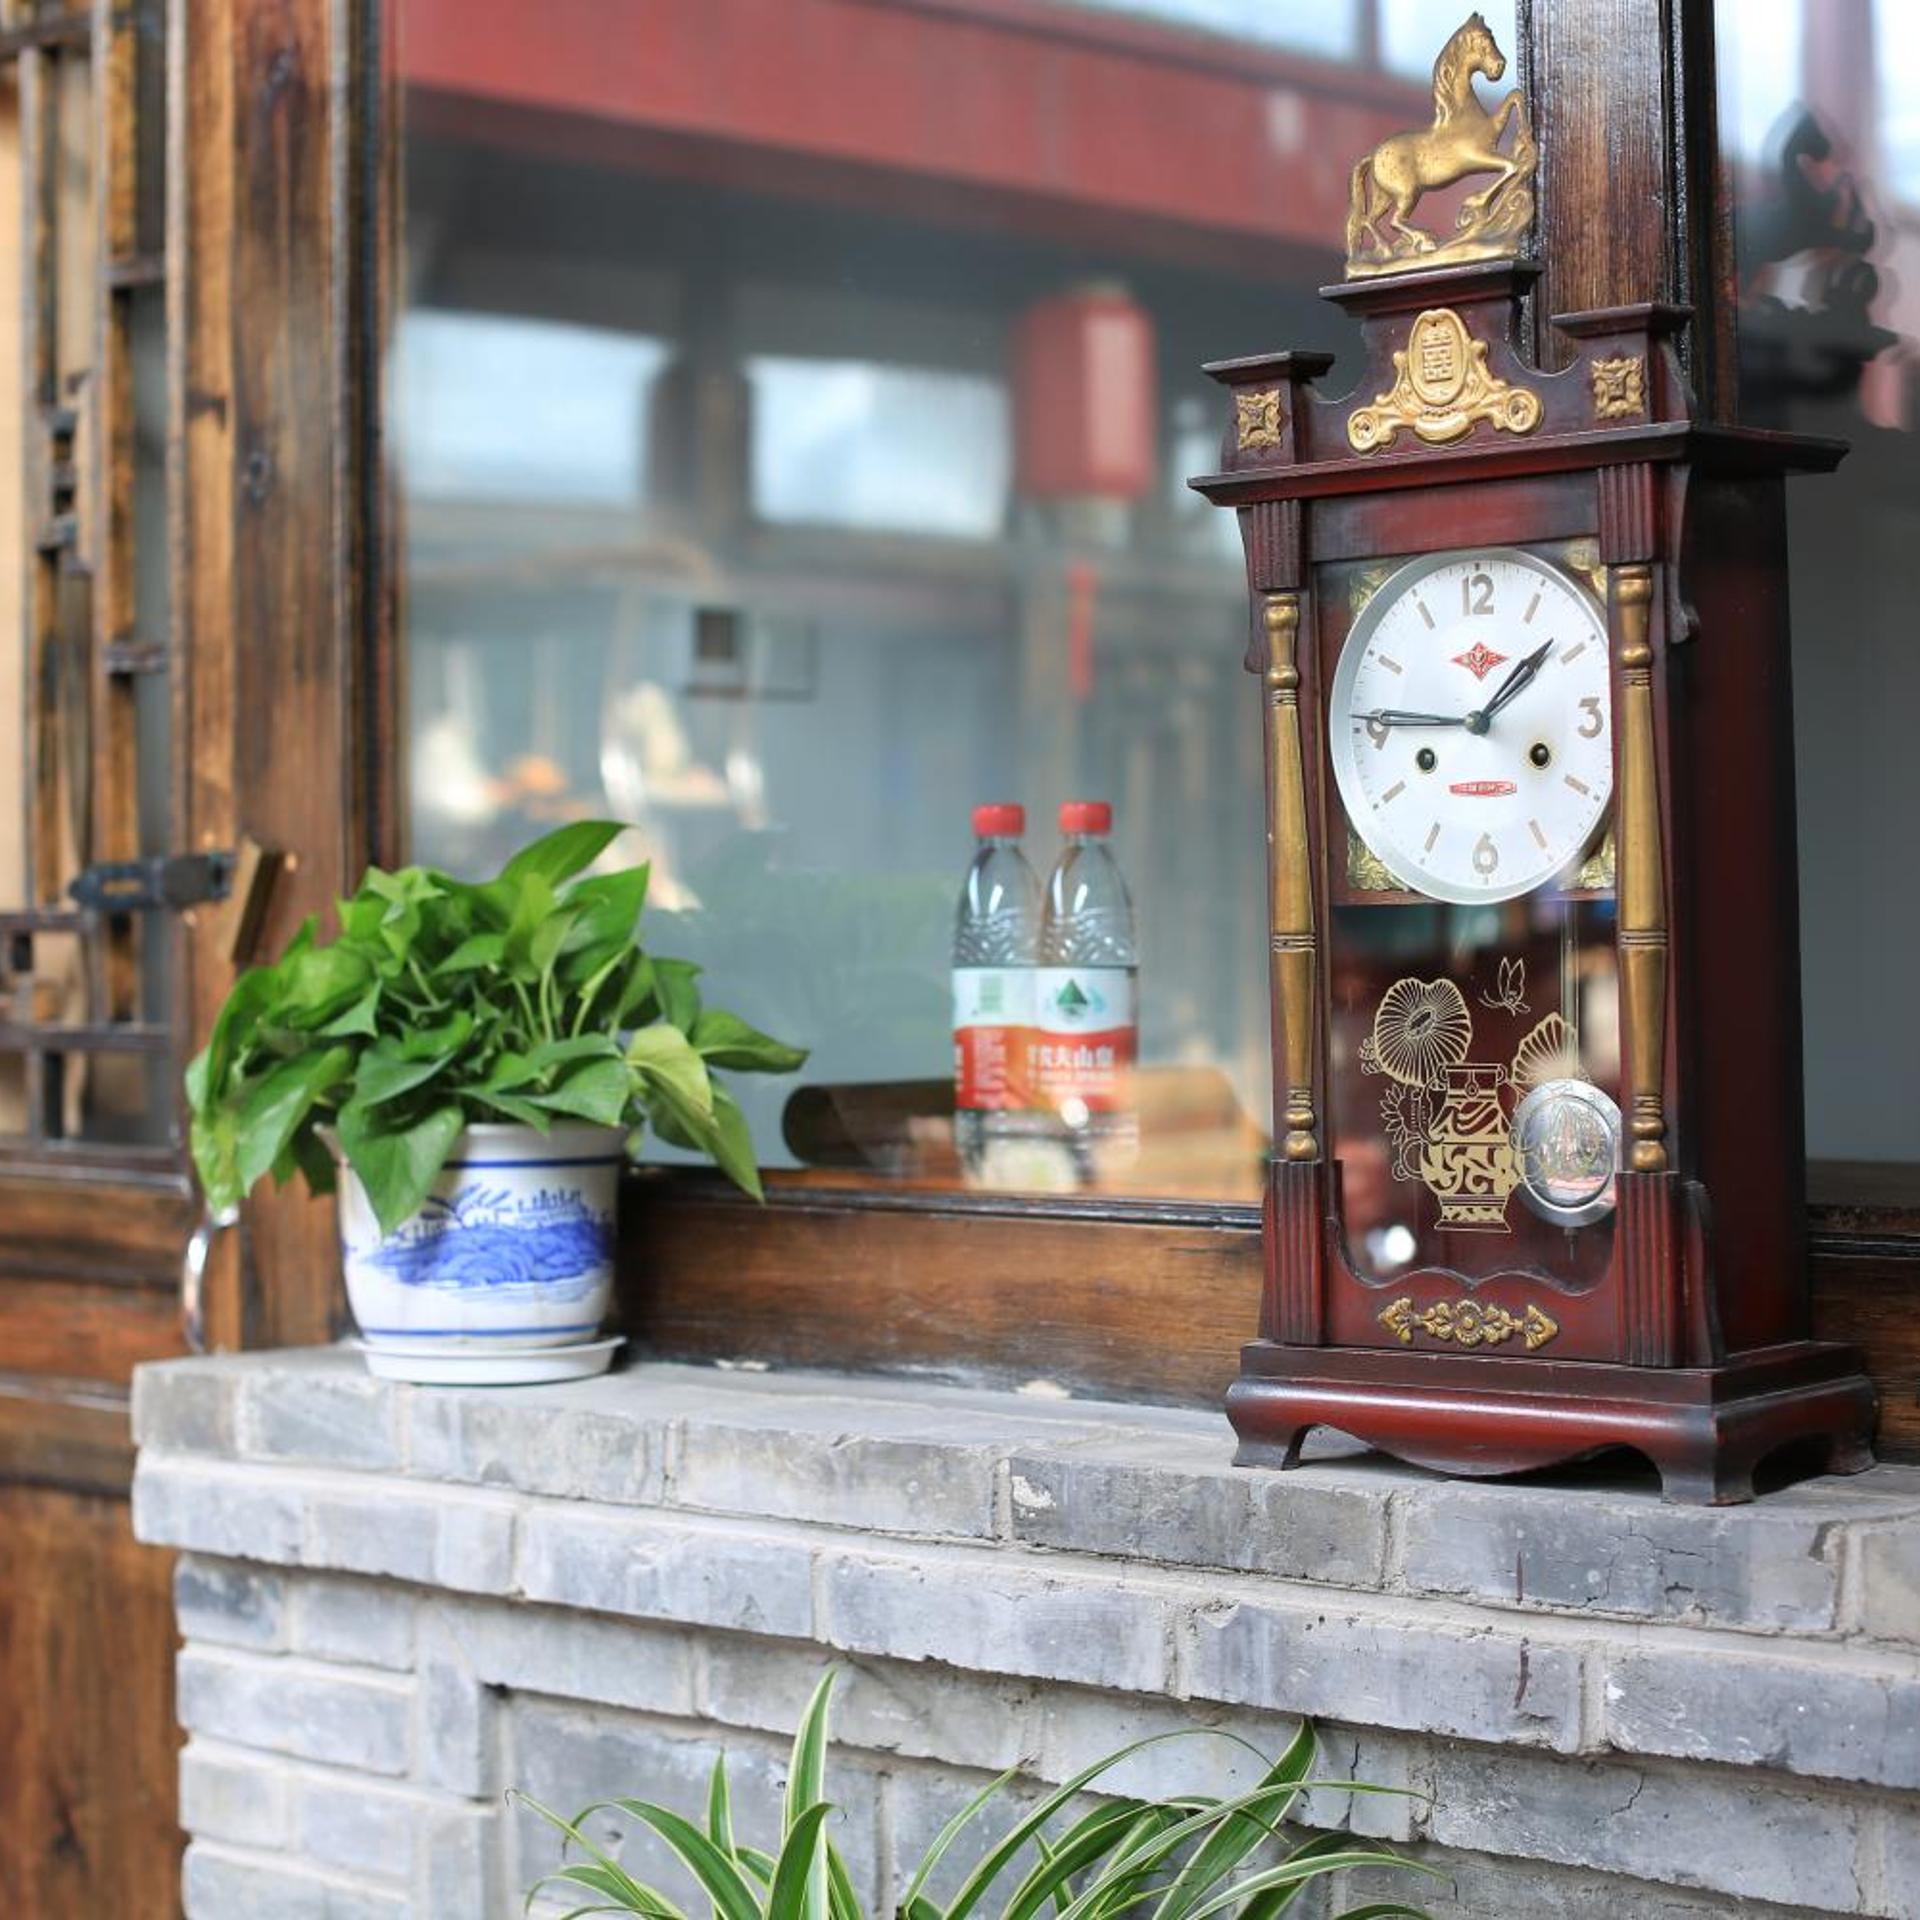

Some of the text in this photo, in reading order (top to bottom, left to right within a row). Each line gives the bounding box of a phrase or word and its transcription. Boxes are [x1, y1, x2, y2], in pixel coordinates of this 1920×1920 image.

[1461, 573, 1495, 617] 12
[1366, 708, 1392, 751] 9
[1577, 696, 1603, 739] 3
[1472, 832, 1498, 875] 6
